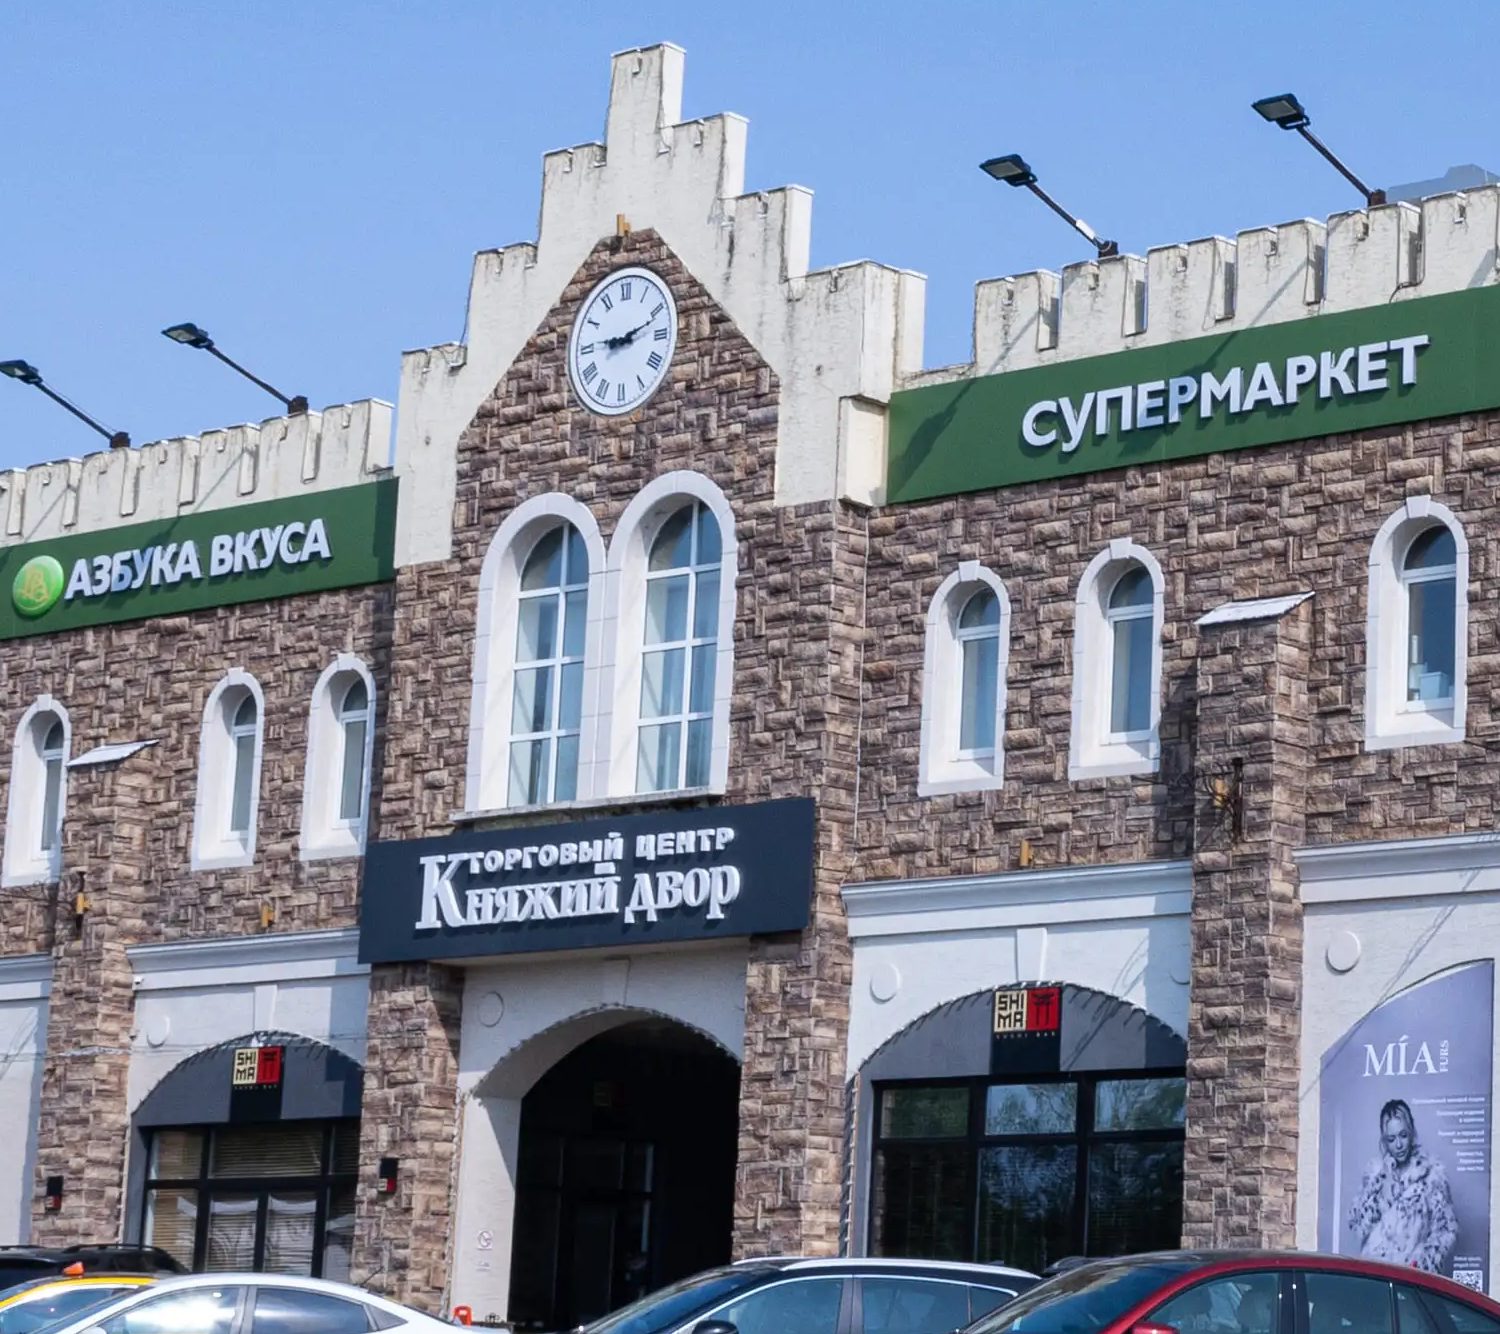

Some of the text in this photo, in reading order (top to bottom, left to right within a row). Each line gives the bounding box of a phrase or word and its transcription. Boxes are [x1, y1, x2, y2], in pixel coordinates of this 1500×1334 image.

[1022, 334, 1429, 453] СУПЕРМАРКЕТ
[64, 518, 331, 600] АЗБУКА ВКУСА
[469, 827, 734, 875] ТОРГОВЫЙ ЦЕНТР
[997, 993, 1024, 1011] SHI
[997, 1011, 1024, 1028] MA
[237, 1051, 257, 1066] SHI
[1363, 1035, 1438, 1077] MÍA
[1439, 1039, 1449, 1073] FURS
[235, 1067, 255, 1081] MA
